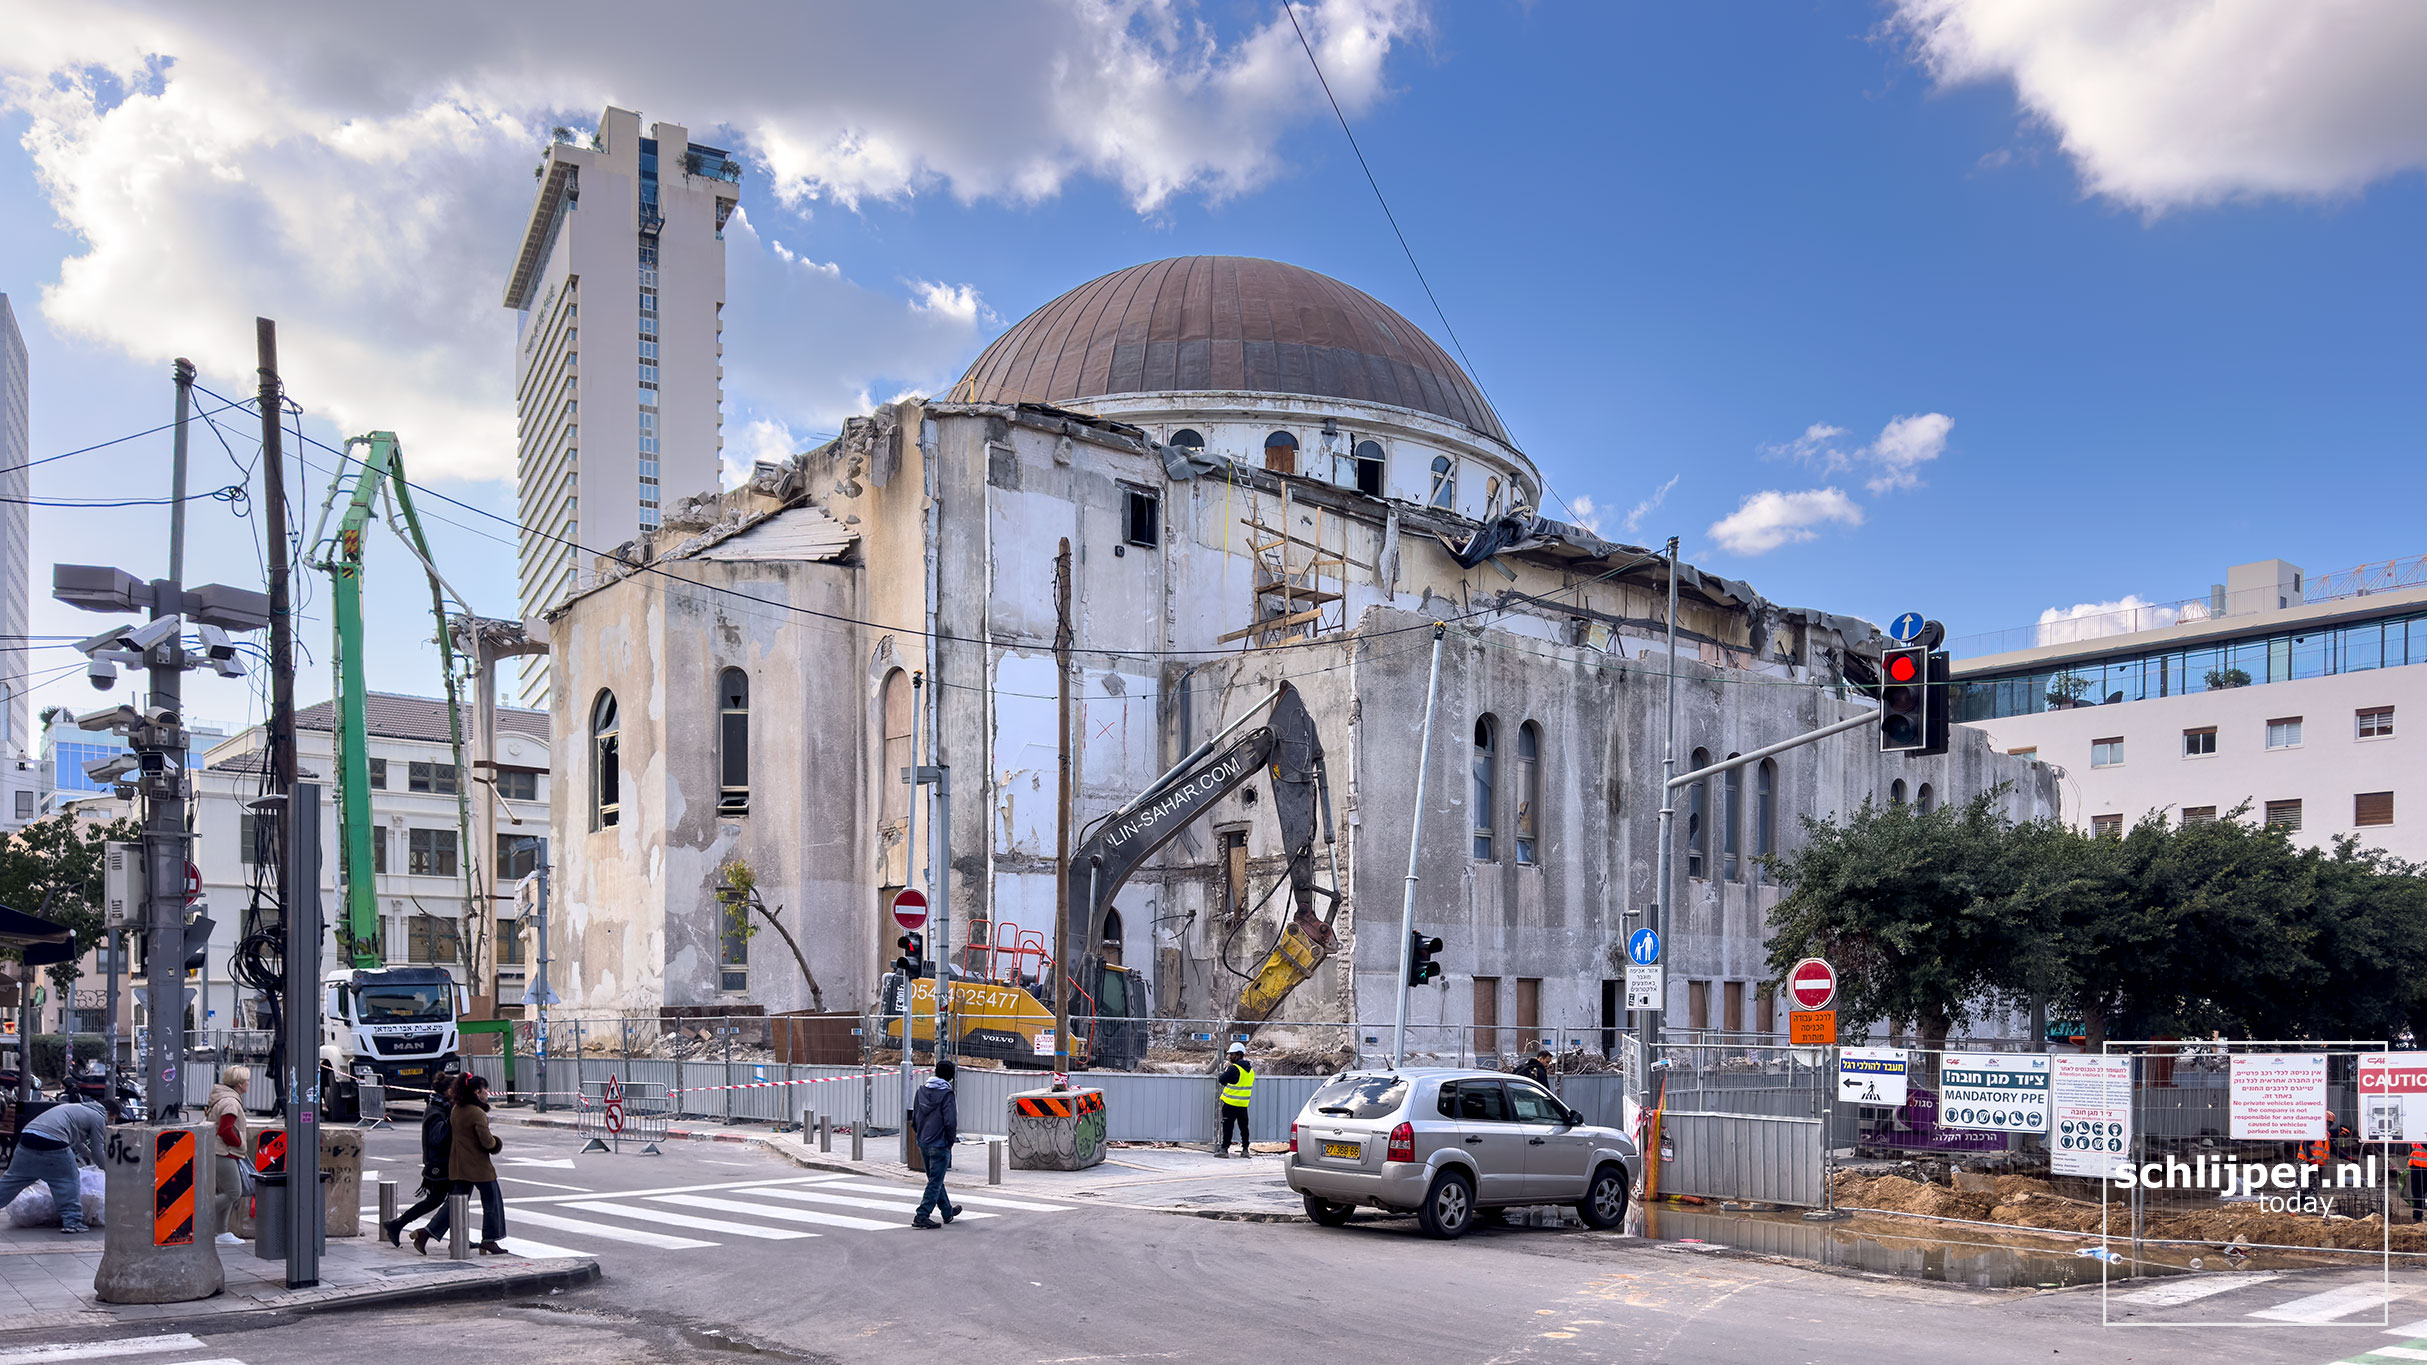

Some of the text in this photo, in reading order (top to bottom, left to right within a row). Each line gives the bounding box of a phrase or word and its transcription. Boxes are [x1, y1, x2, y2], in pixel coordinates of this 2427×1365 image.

[982, 1034, 1015, 1044] VOLVO
[393, 1042, 425, 1050] MAN
[1842, 1059, 1904, 1072] מעבר להולכי רגל
[1946, 1070, 2045, 1087] ציוד מגן חובה!
[1945, 1090, 2018, 1102] MANDATORY
[2021, 1093, 2045, 1104] PPE
[1932, 1131, 1998, 1142] הרכבת הקלה.
